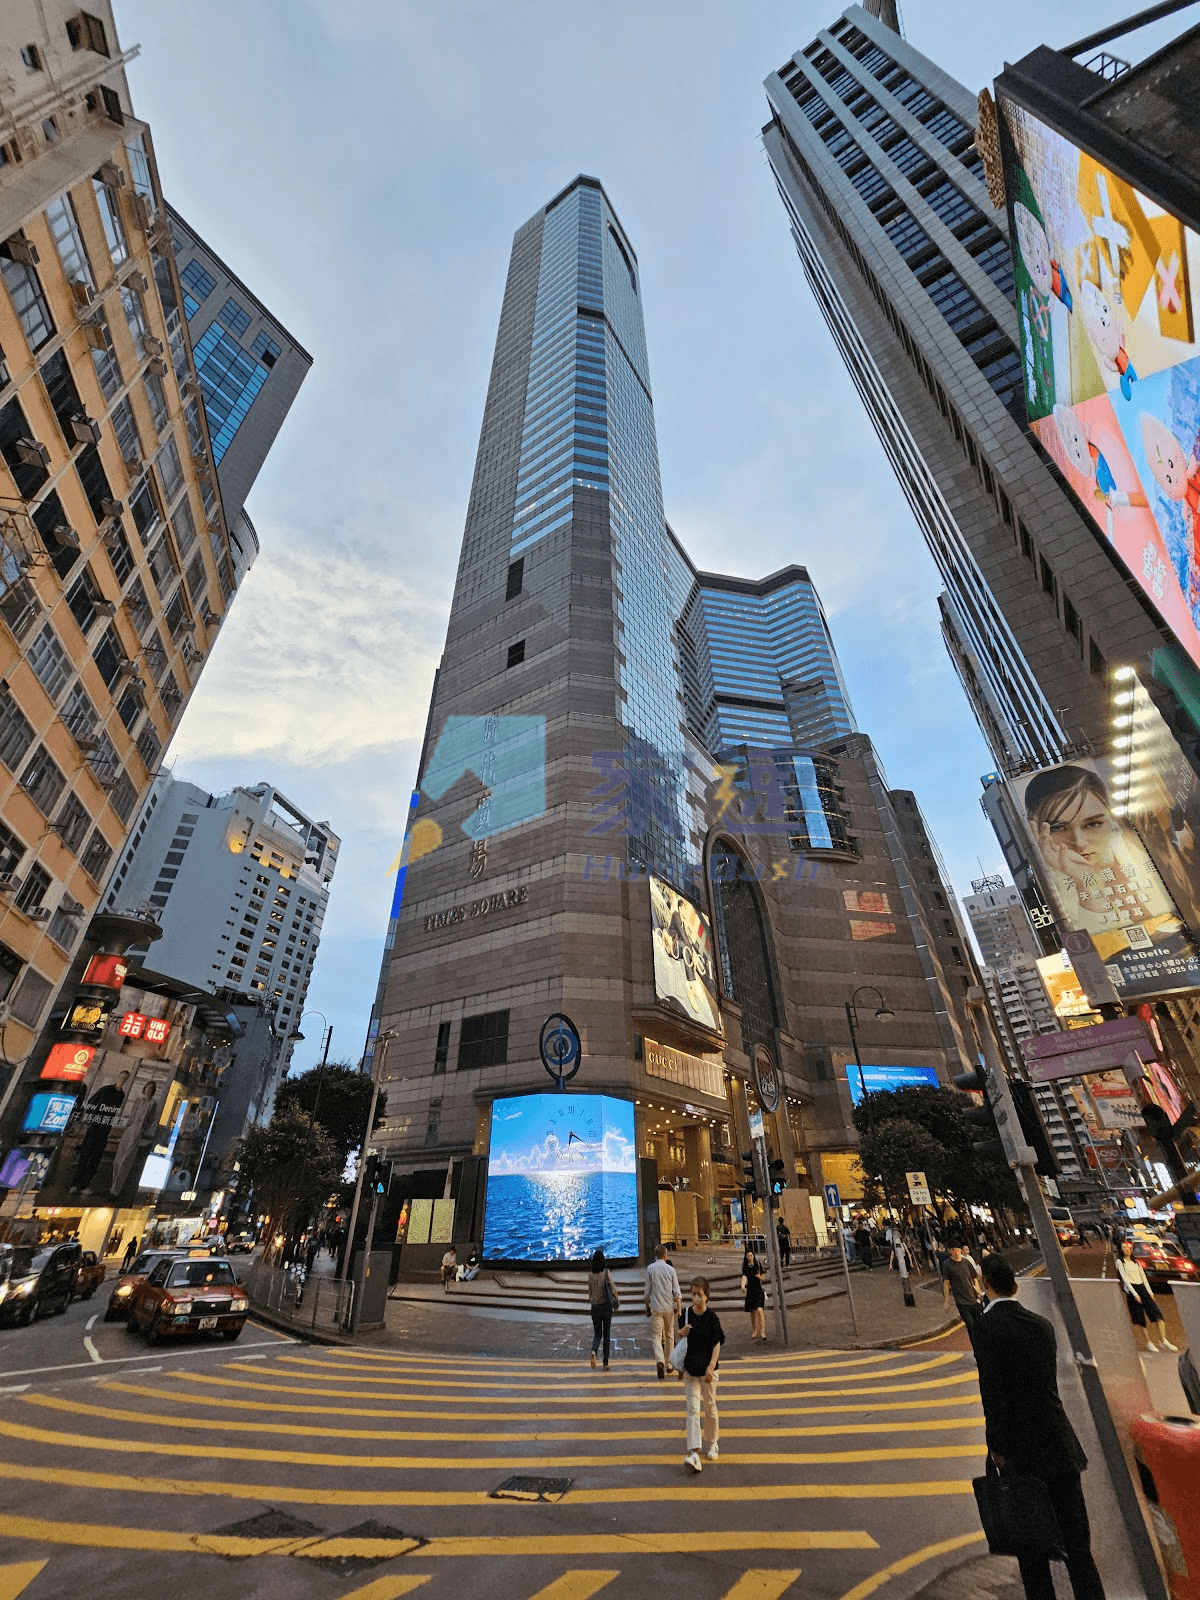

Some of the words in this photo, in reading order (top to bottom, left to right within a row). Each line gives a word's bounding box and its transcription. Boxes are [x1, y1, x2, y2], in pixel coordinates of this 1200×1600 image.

[468, 710, 500, 878] 時代廣場
[424, 906, 467, 932] TIMES
[471, 886, 529, 917] SQUARE
[1122, 948, 1171, 962] MaBelle
[1166, 965, 1186, 975] 3925
[126, 1014, 143, 1026] ユニ
[150, 1021, 166, 1031] UNI
[122, 1024, 140, 1035] クロ
[147, 1030, 164, 1040] QLO
[648, 1052, 678, 1071] GUCCI
